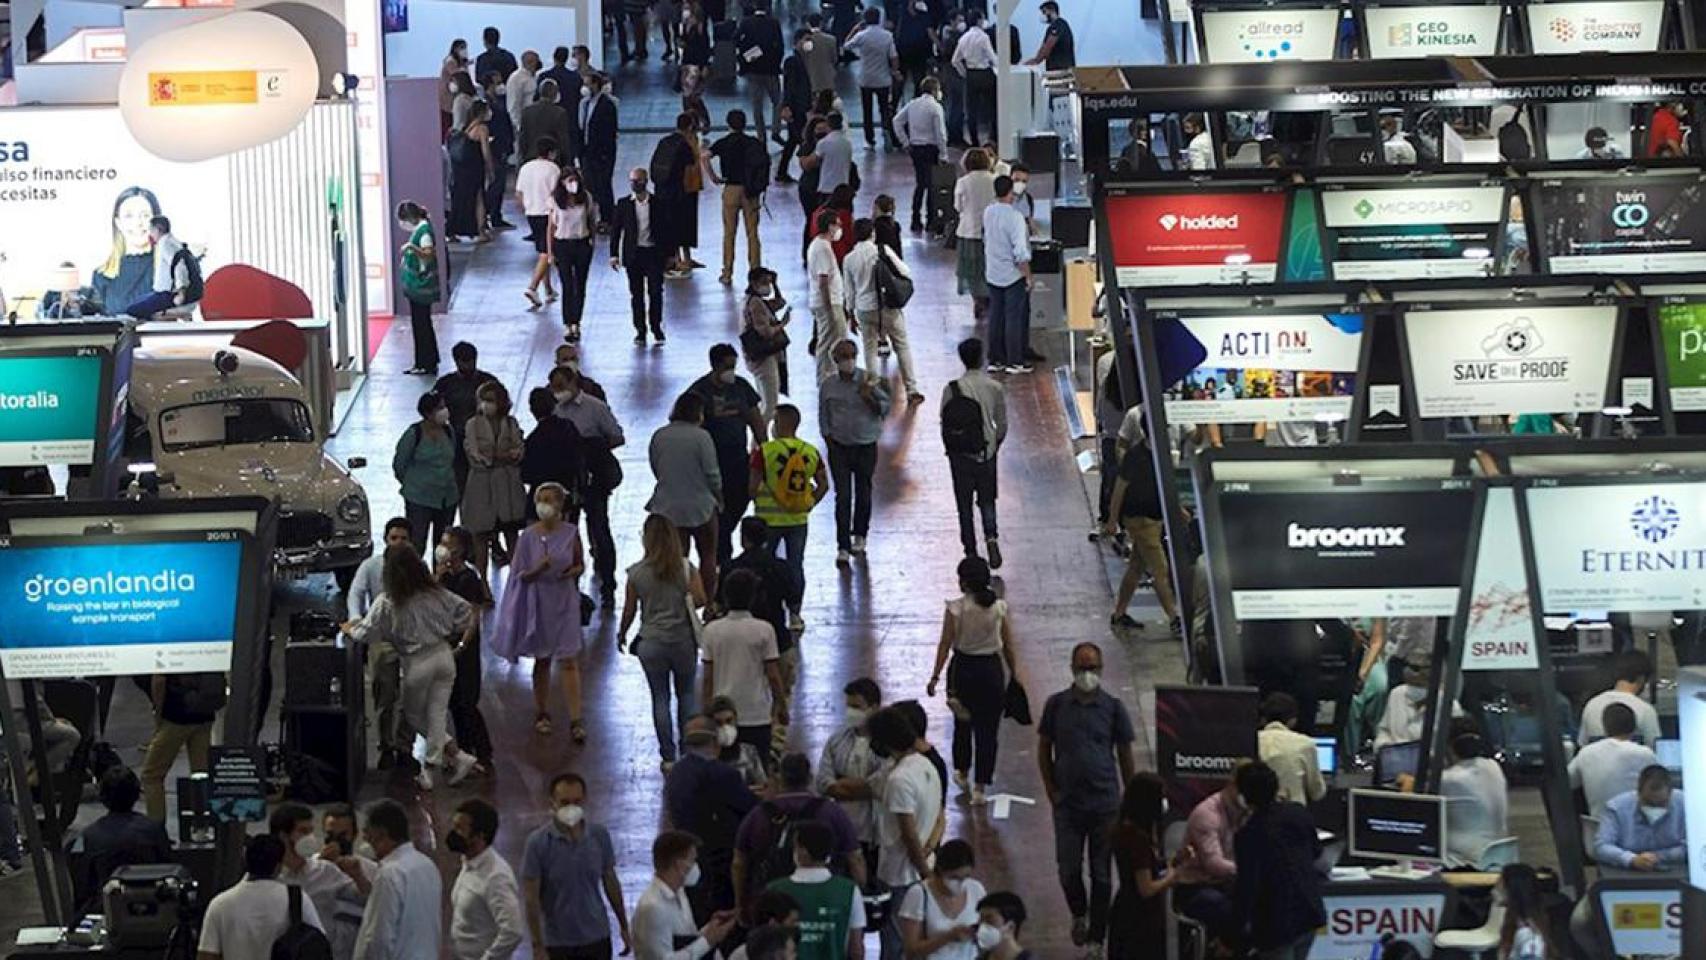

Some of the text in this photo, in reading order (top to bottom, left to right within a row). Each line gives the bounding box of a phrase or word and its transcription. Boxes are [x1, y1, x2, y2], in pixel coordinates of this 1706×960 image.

[1248, 22, 1304, 35] allread
[1417, 22, 1448, 33] GEO
[1418, 33, 1477, 46] KINESIA
[1584, 31, 1641, 40] COMPANY
[1399, 88, 1430, 101] THE
[1471, 85, 1568, 100] GENERATION
[1571, 84, 1592, 97] OF
[33, 165, 117, 180] financiero
[1616, 190, 1646, 203] twin
[1180, 213, 1239, 230] holded
[1454, 362, 1498, 381] SAVE
[1520, 361, 1569, 379] PROOF
[1288, 523, 1405, 547] broomx
[25, 570, 196, 602] groenlandia
[46, 598, 180, 613] Raising the bar in biological
[72, 611, 155, 624] sample transport
[1471, 641, 1529, 657] SPAIN
[1331, 907, 1436, 935] SPAIN
